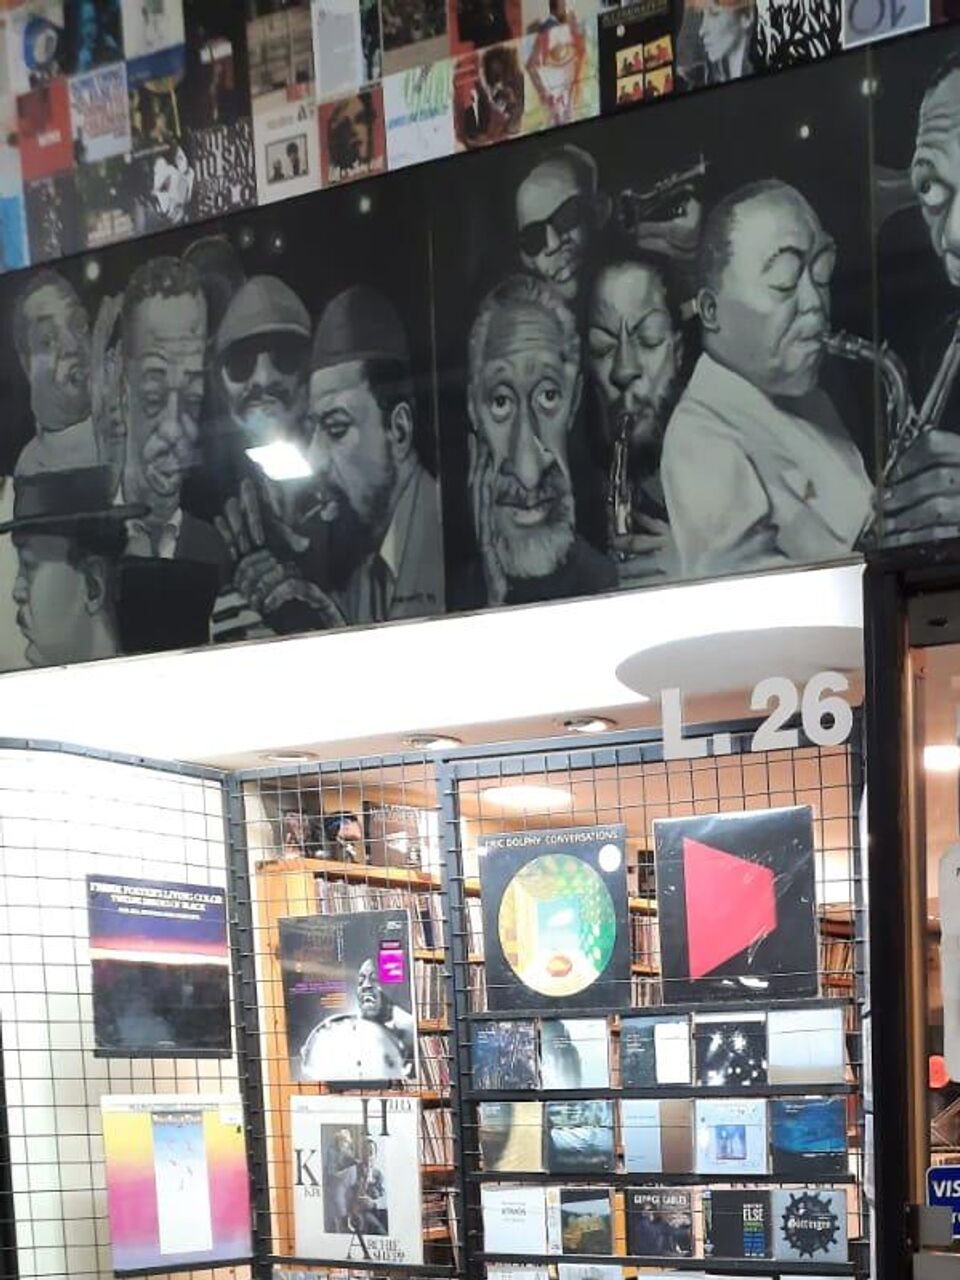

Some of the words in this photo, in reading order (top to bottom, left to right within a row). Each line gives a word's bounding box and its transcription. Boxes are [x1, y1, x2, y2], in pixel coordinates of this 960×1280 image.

[751, 670, 853, 751] 26
[505, 836, 541, 848] DOLPHY
[545, 831, 618, 845] CONVERSATIONS
[743, 1209, 764, 1222] ELSE
